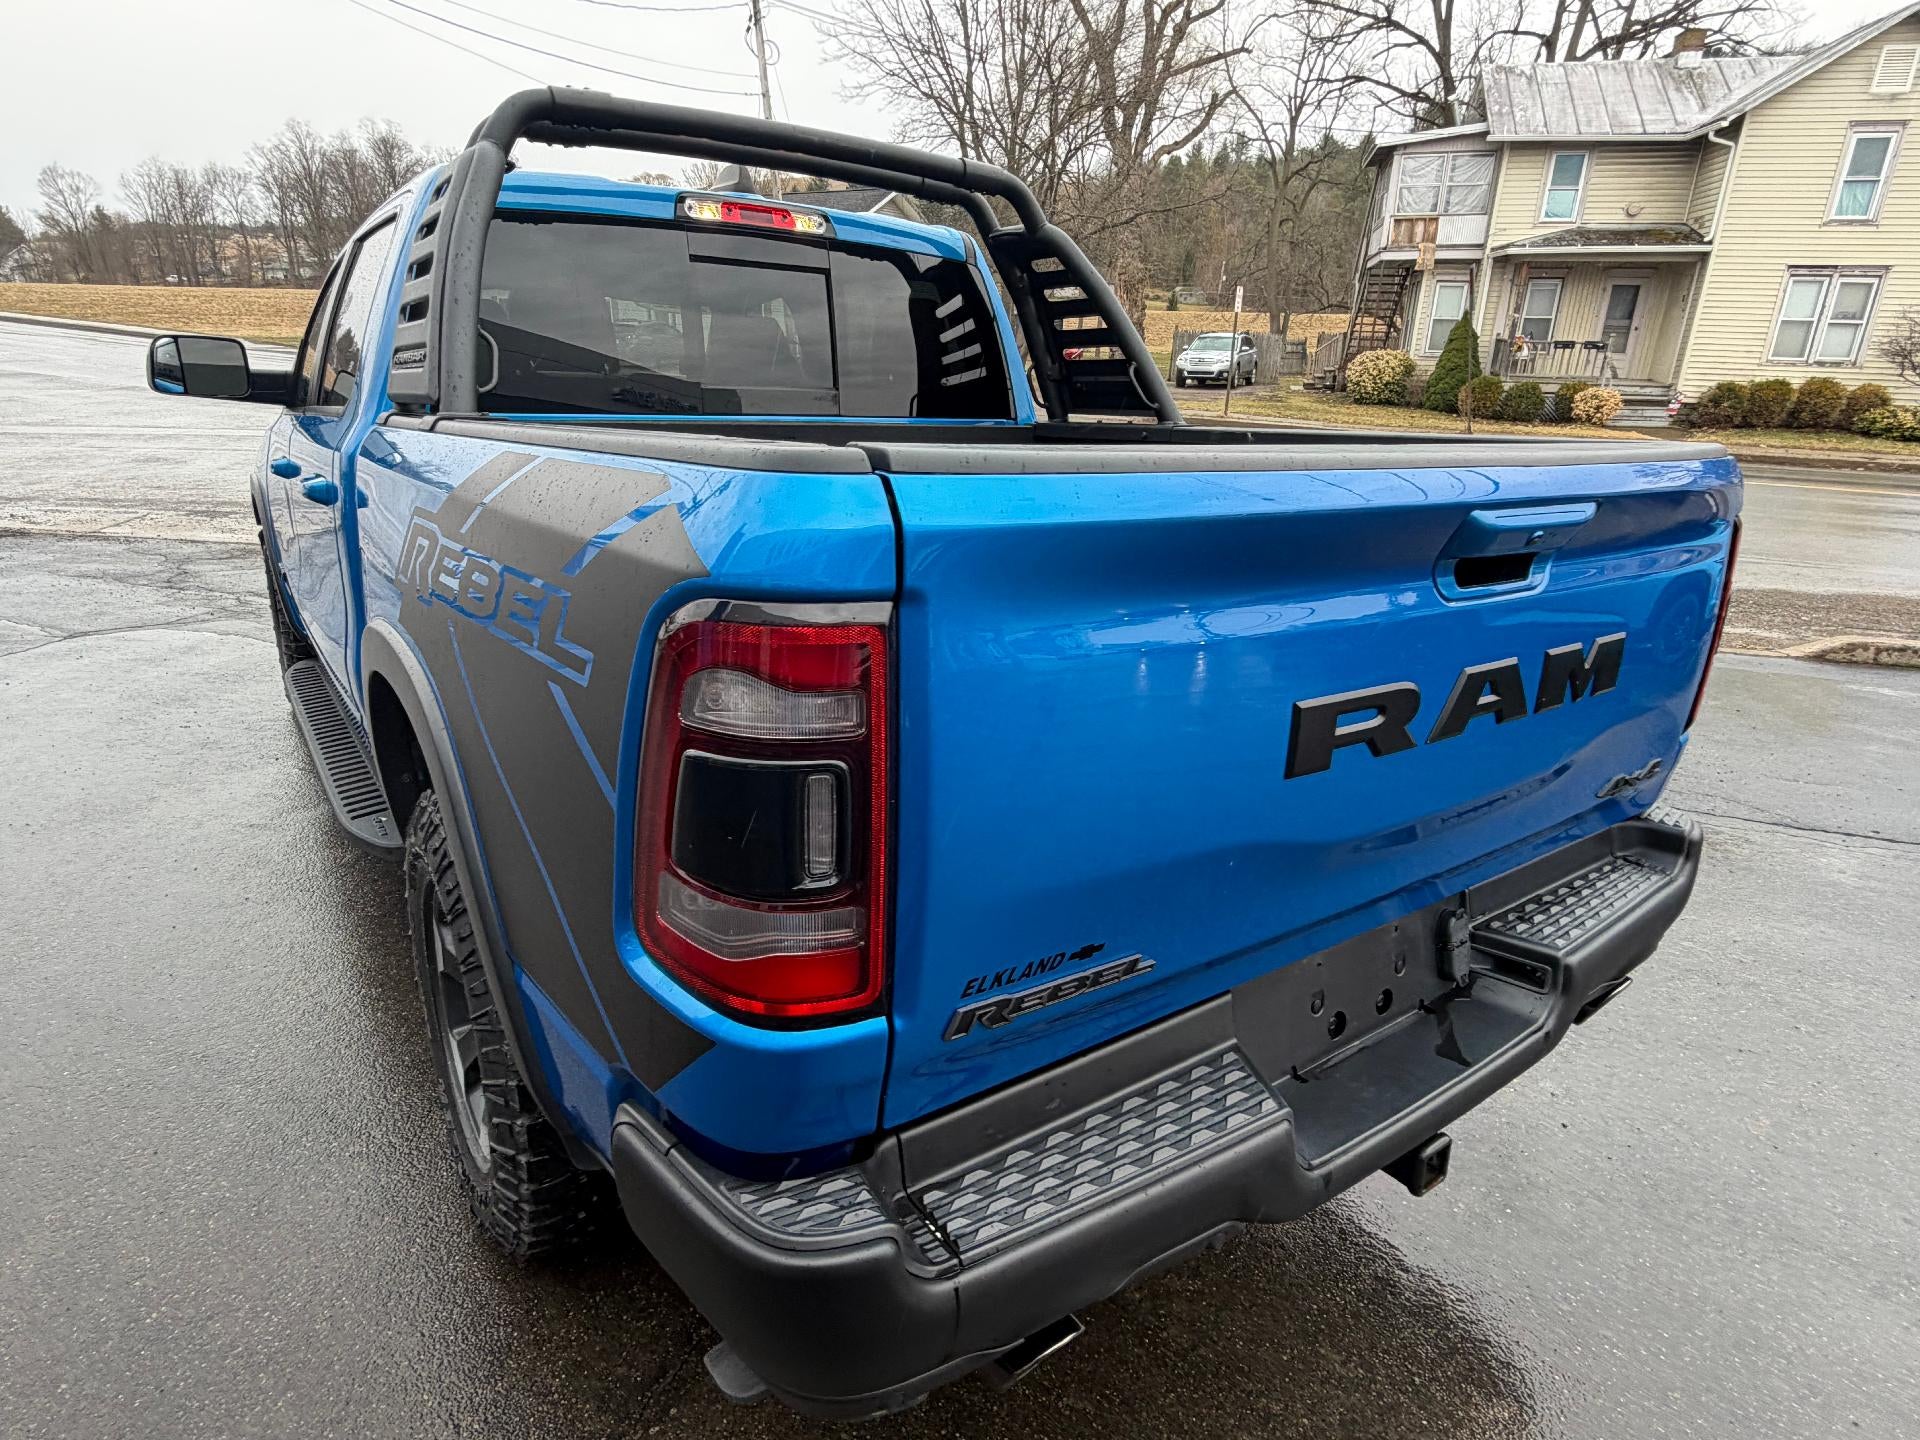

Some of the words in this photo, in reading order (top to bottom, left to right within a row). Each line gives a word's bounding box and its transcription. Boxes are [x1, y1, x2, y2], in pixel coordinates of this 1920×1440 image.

[398, 514, 594, 688] REBEL
[1283, 631, 1627, 780] RAM
[942, 953, 1156, 1042] REBEL
[960, 951, 1067, 999] ELKLAND
